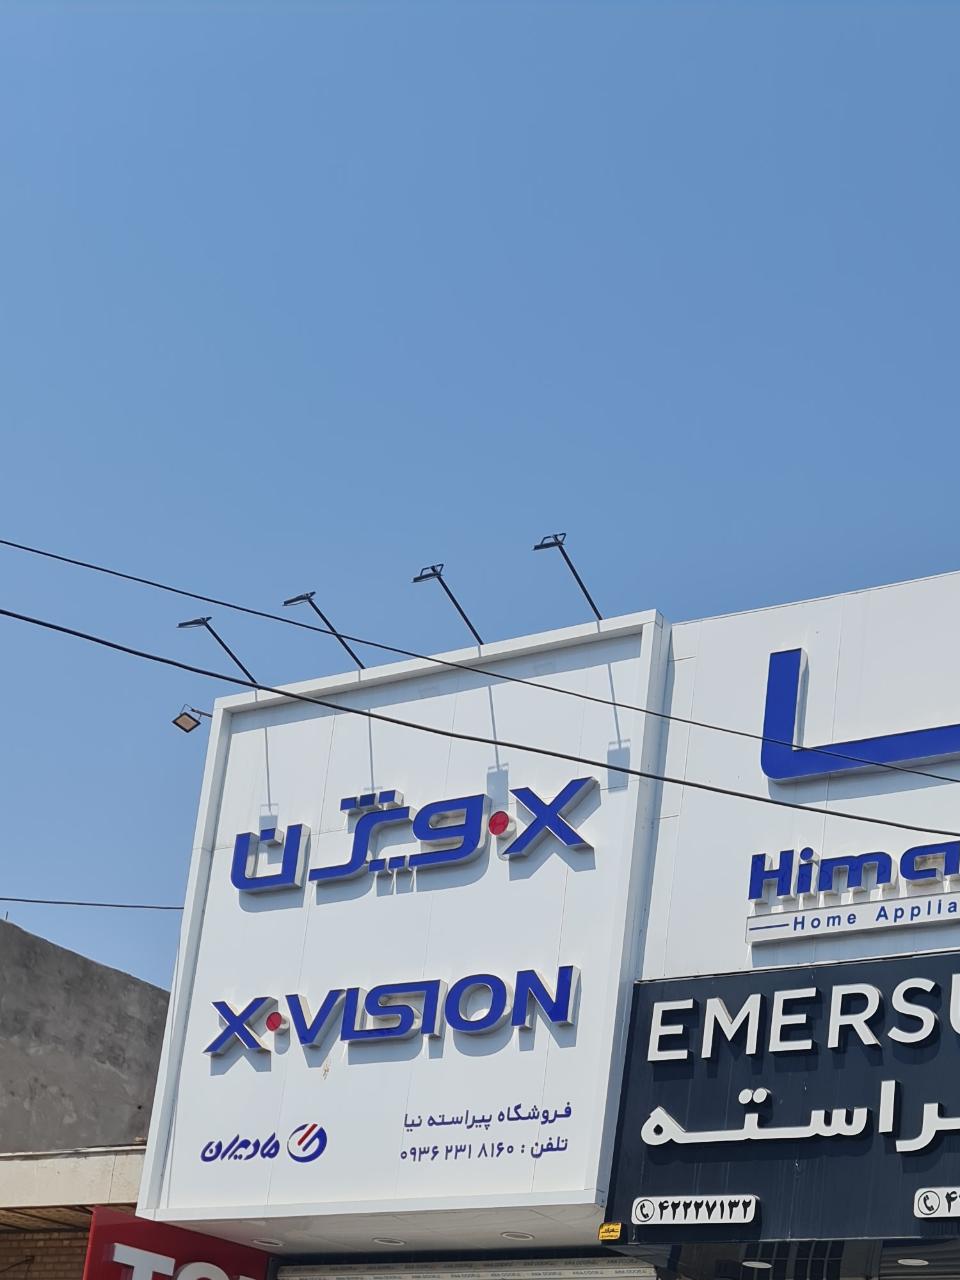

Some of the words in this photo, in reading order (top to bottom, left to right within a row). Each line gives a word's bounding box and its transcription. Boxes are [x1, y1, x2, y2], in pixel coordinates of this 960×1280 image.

[792, 911, 858, 932] Home
[402, 1112, 423, 1132] نیا
[426, 1109, 493, 1131] پیراسته
[497, 1101, 573, 1125] فروشگاه
[530, 1136, 569, 1159] تلفن
[657, 1199, 753, 1221] ۴۲۲۲۷۱۳۲
